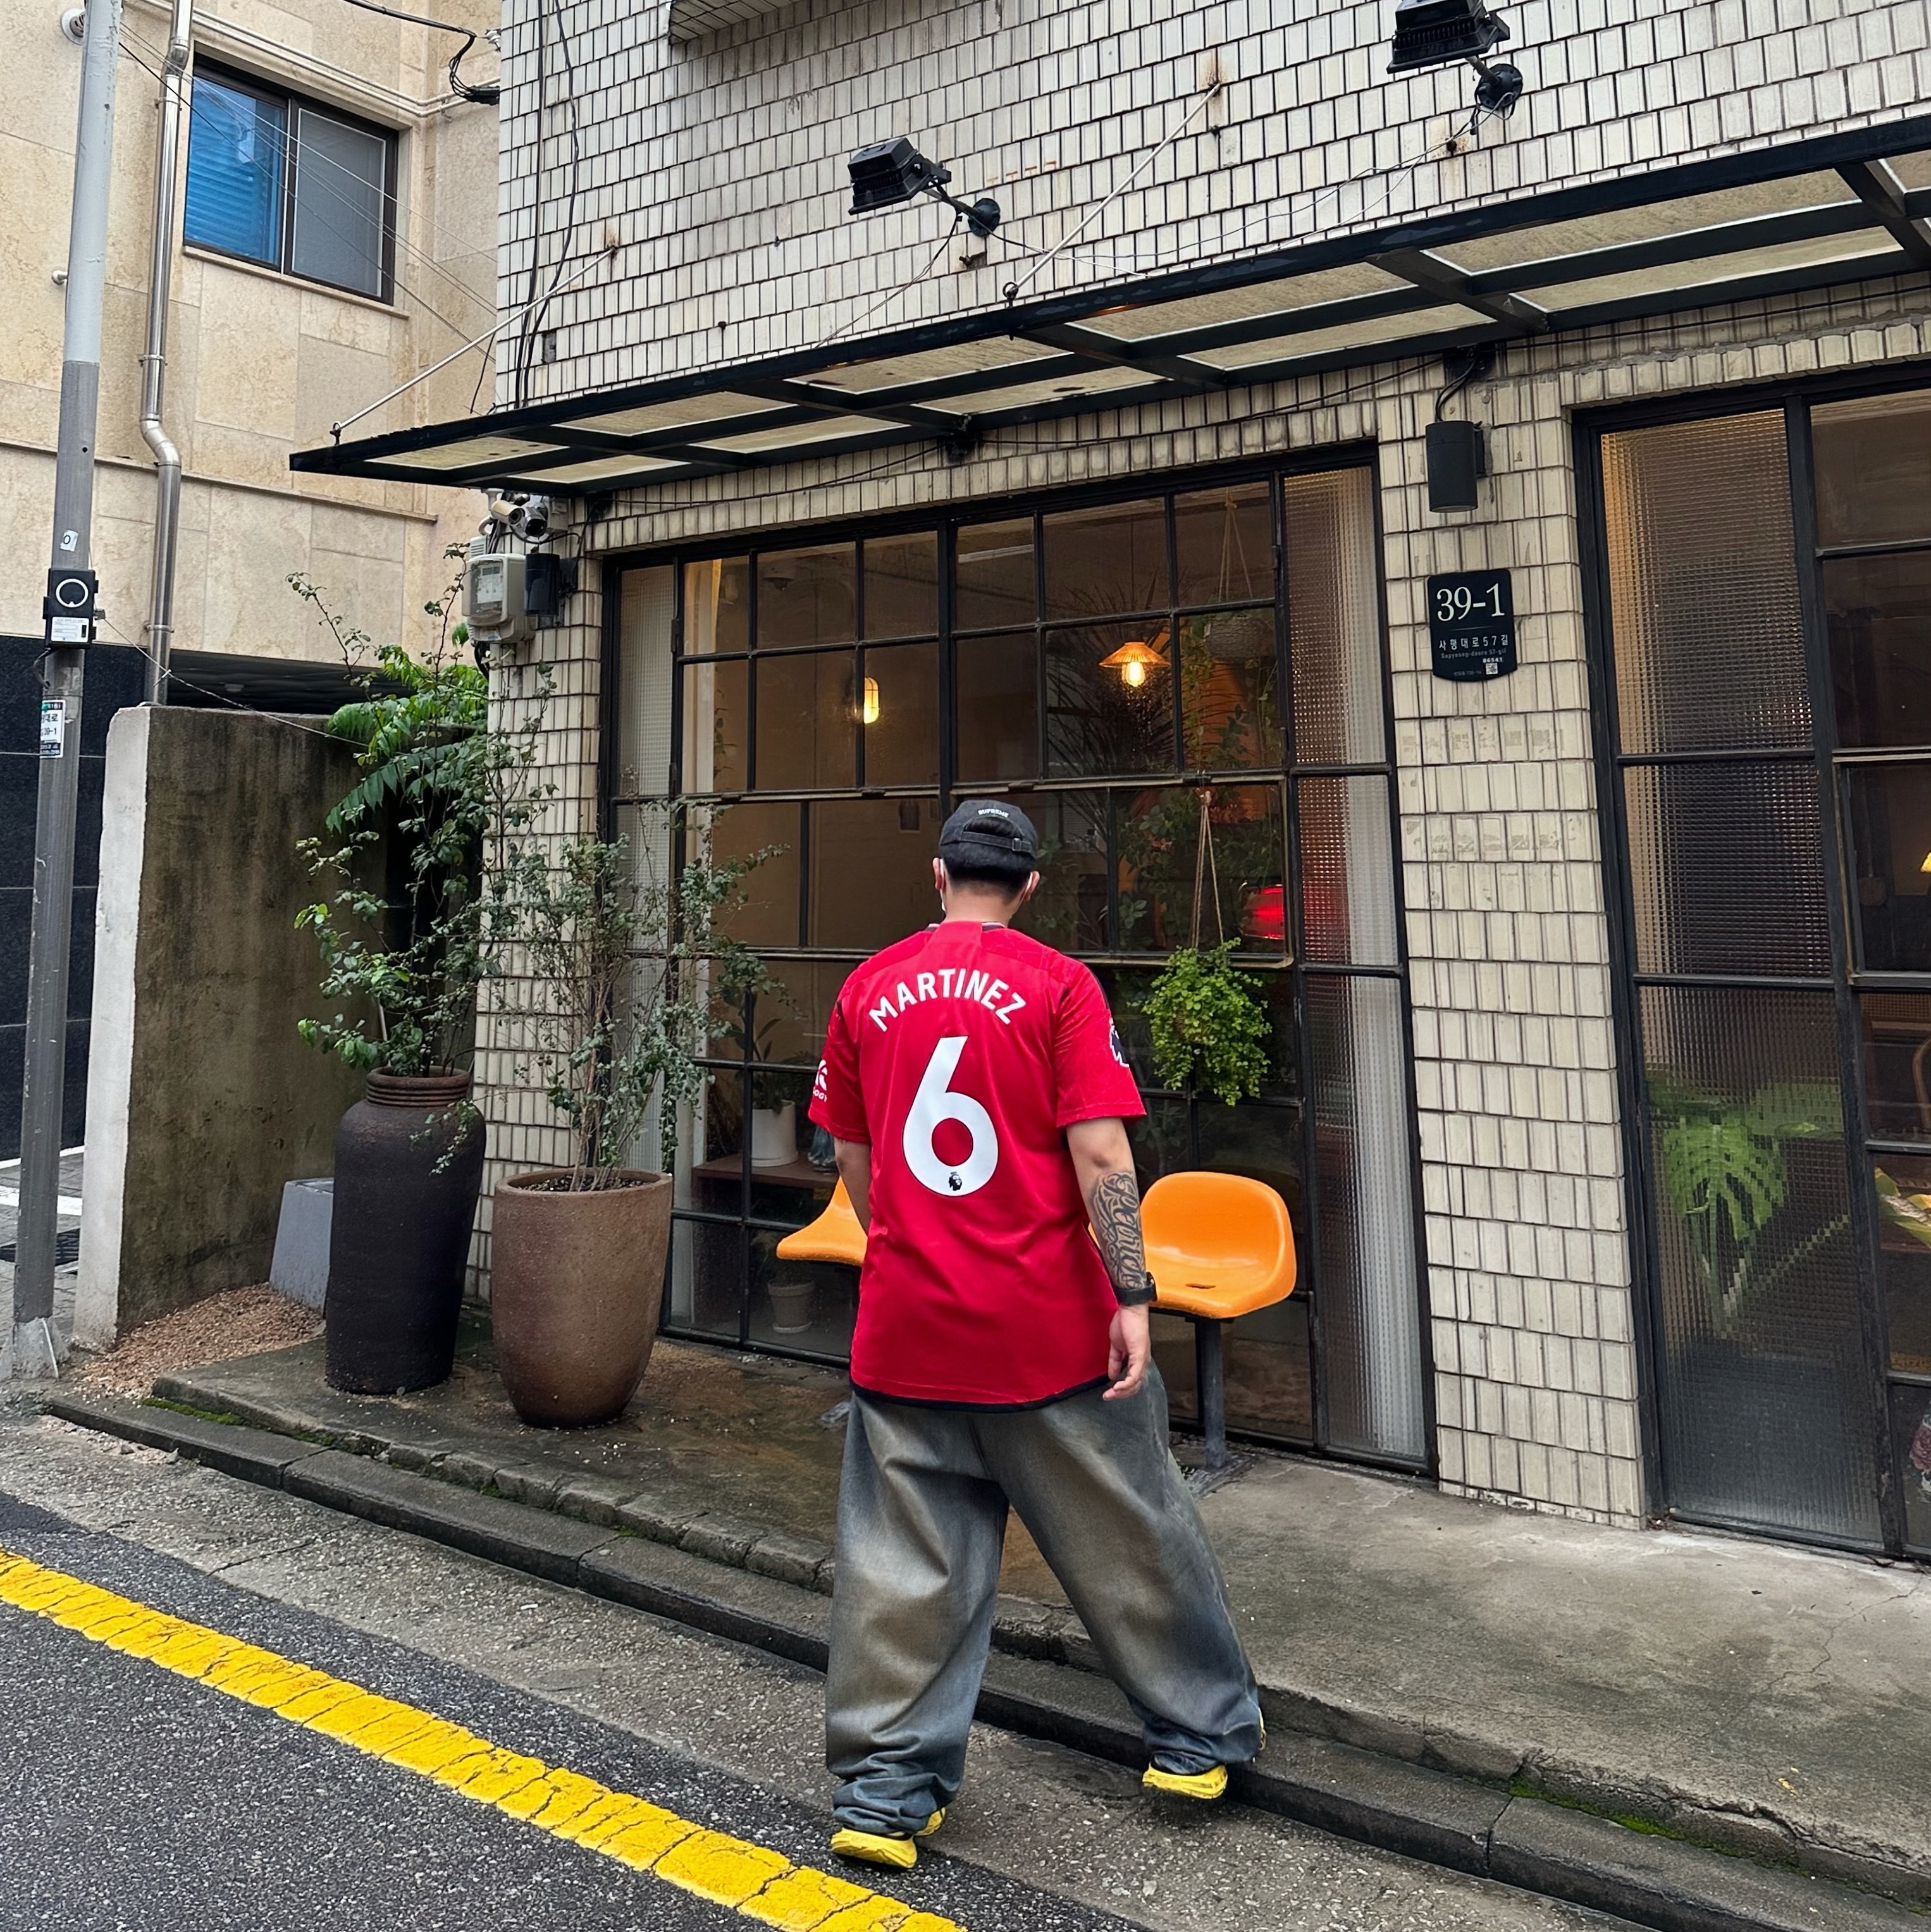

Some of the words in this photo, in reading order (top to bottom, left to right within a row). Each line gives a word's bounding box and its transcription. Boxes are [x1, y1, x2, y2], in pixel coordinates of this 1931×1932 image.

[1436, 583, 1505, 622] 39-1
[978, 808, 1009, 818] SUPREME
[868, 968, 1026, 1032] MARTINEZ
[903, 1035, 999, 1197] 6
